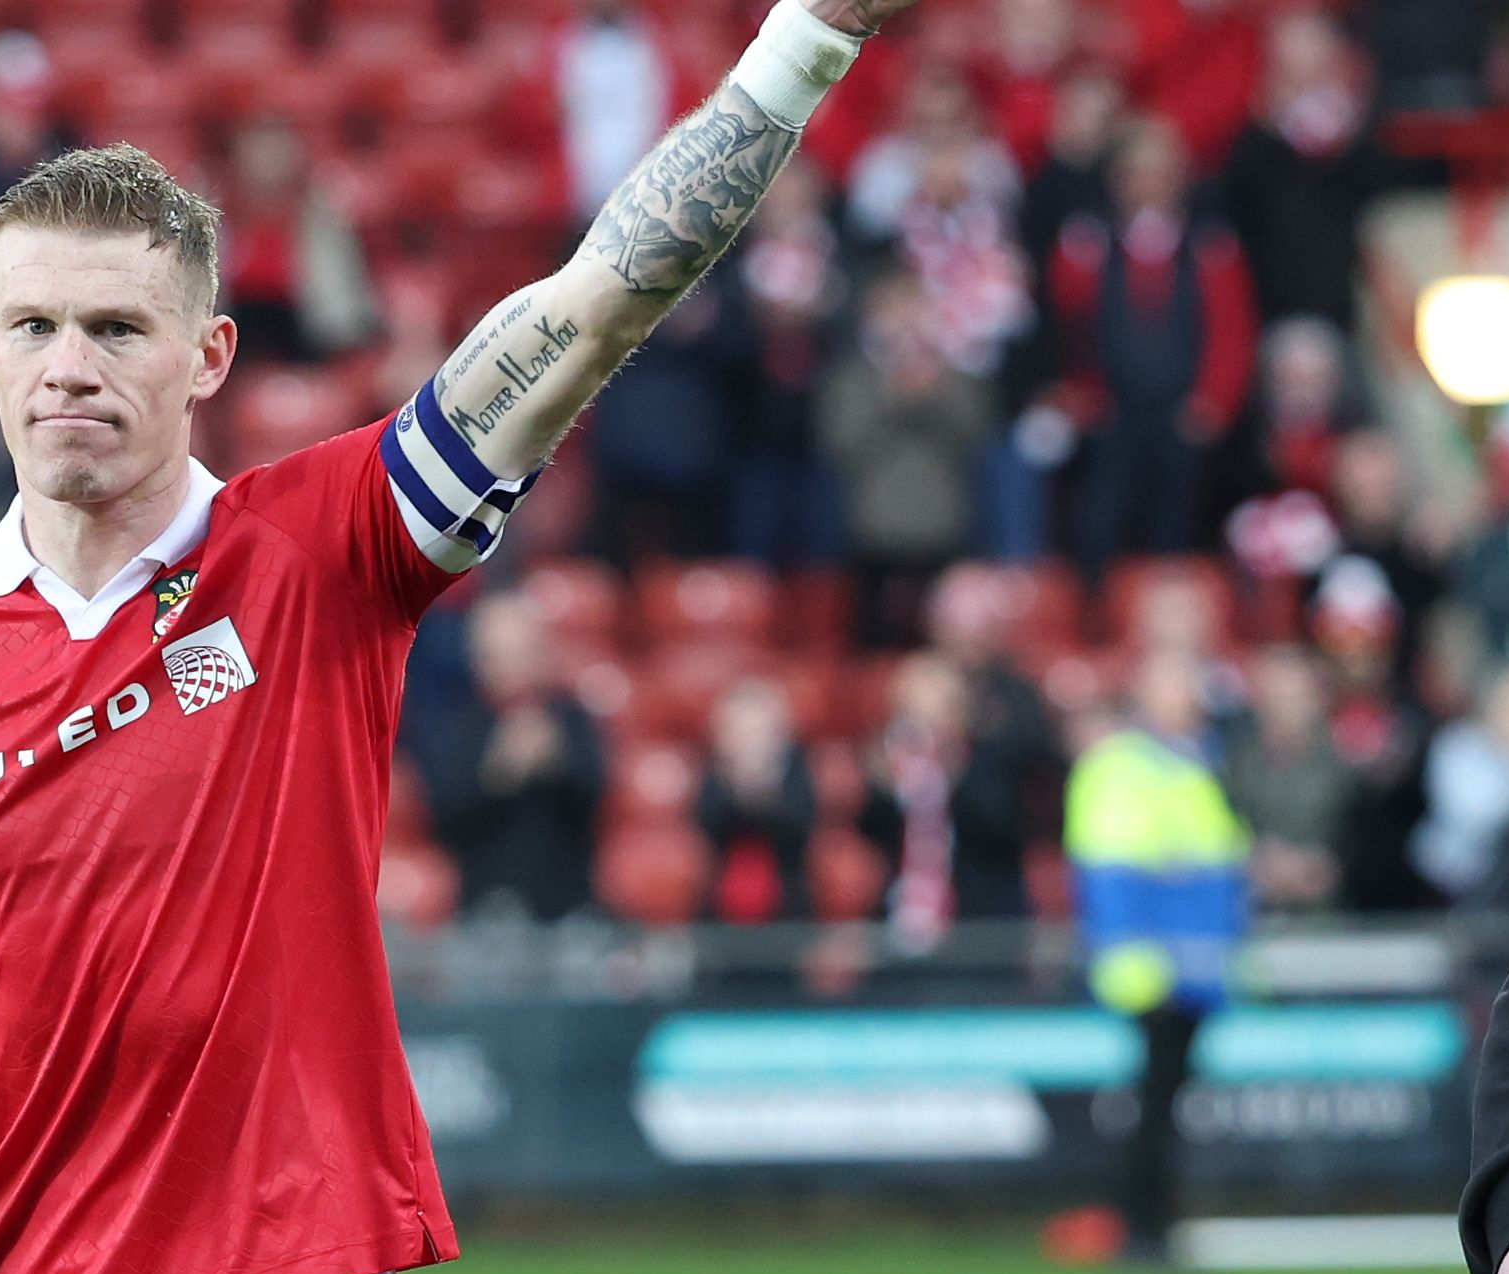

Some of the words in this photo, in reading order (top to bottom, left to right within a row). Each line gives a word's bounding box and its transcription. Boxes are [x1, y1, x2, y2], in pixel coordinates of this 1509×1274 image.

[453, 337, 489, 382] MEANING
[500, 296, 532, 330] FAMILY
[495, 357, 528, 393] I
